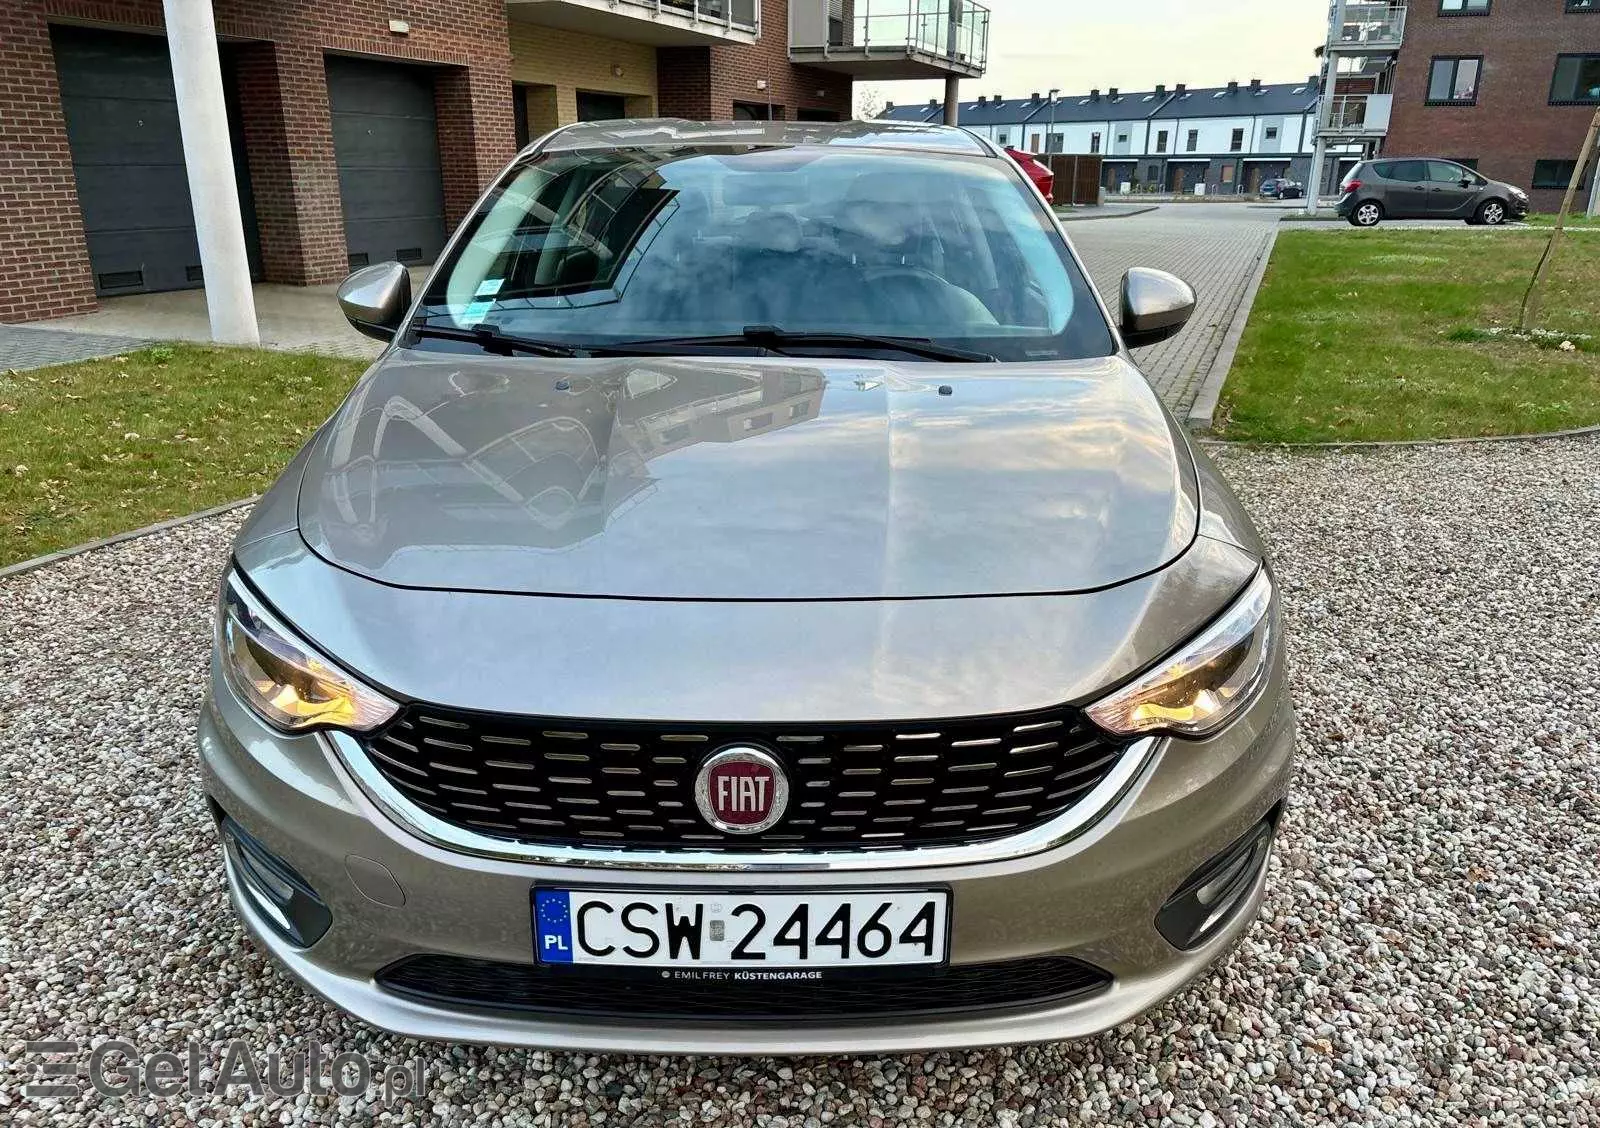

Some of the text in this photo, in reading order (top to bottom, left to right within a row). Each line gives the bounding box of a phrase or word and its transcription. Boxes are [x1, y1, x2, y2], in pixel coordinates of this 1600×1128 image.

[717, 776, 770, 811] FIAT
[544, 934, 568, 950] PL
[577, 900, 936, 960] CSW 24464
[674, 970, 823, 980] EMIL FREY KÜSTENGARAGE
